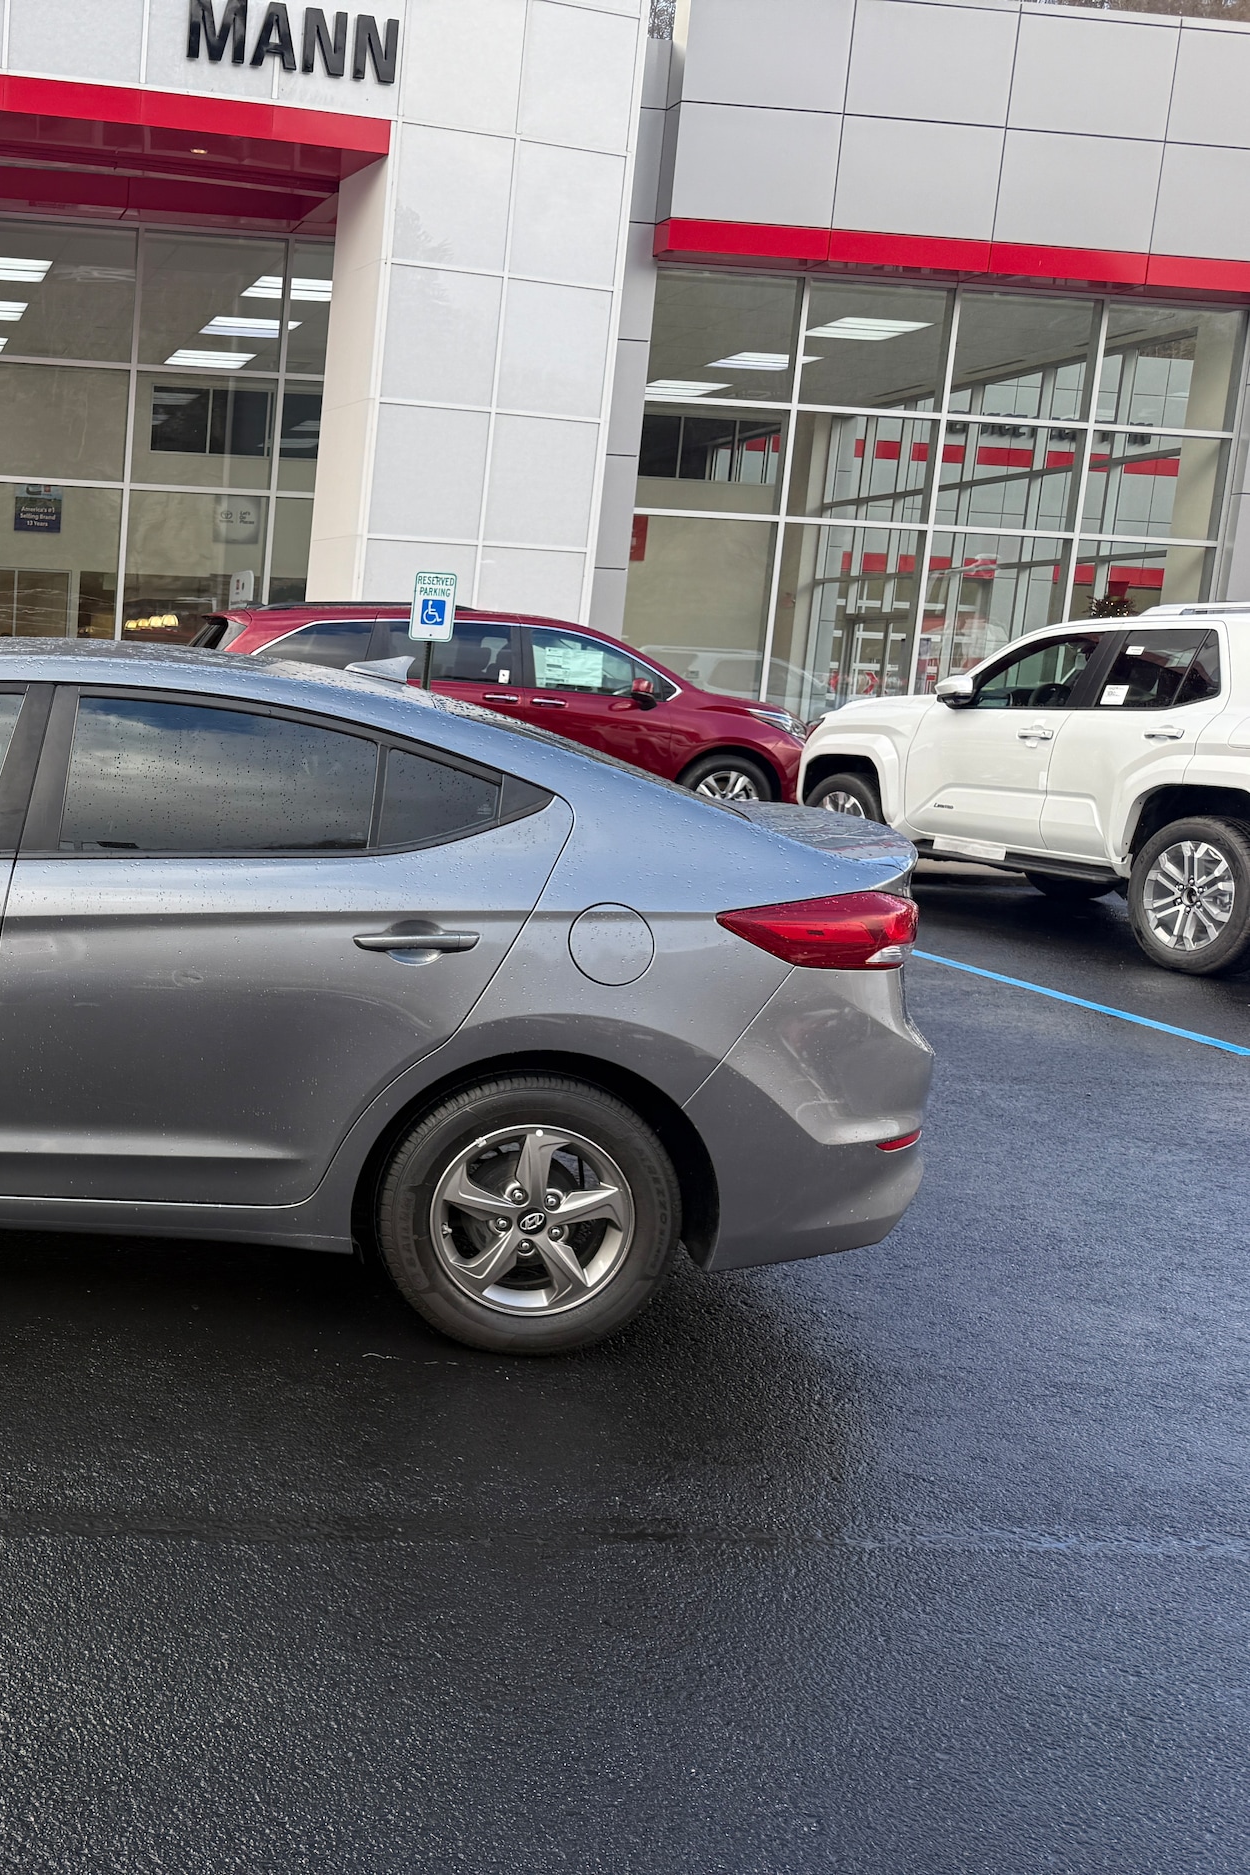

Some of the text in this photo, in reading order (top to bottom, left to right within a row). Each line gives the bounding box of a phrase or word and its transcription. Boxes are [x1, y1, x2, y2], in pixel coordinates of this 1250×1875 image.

[186, 0, 399, 84] MANN
[418, 576, 454, 586] RESERVED
[419, 587, 451, 597] PARKING
